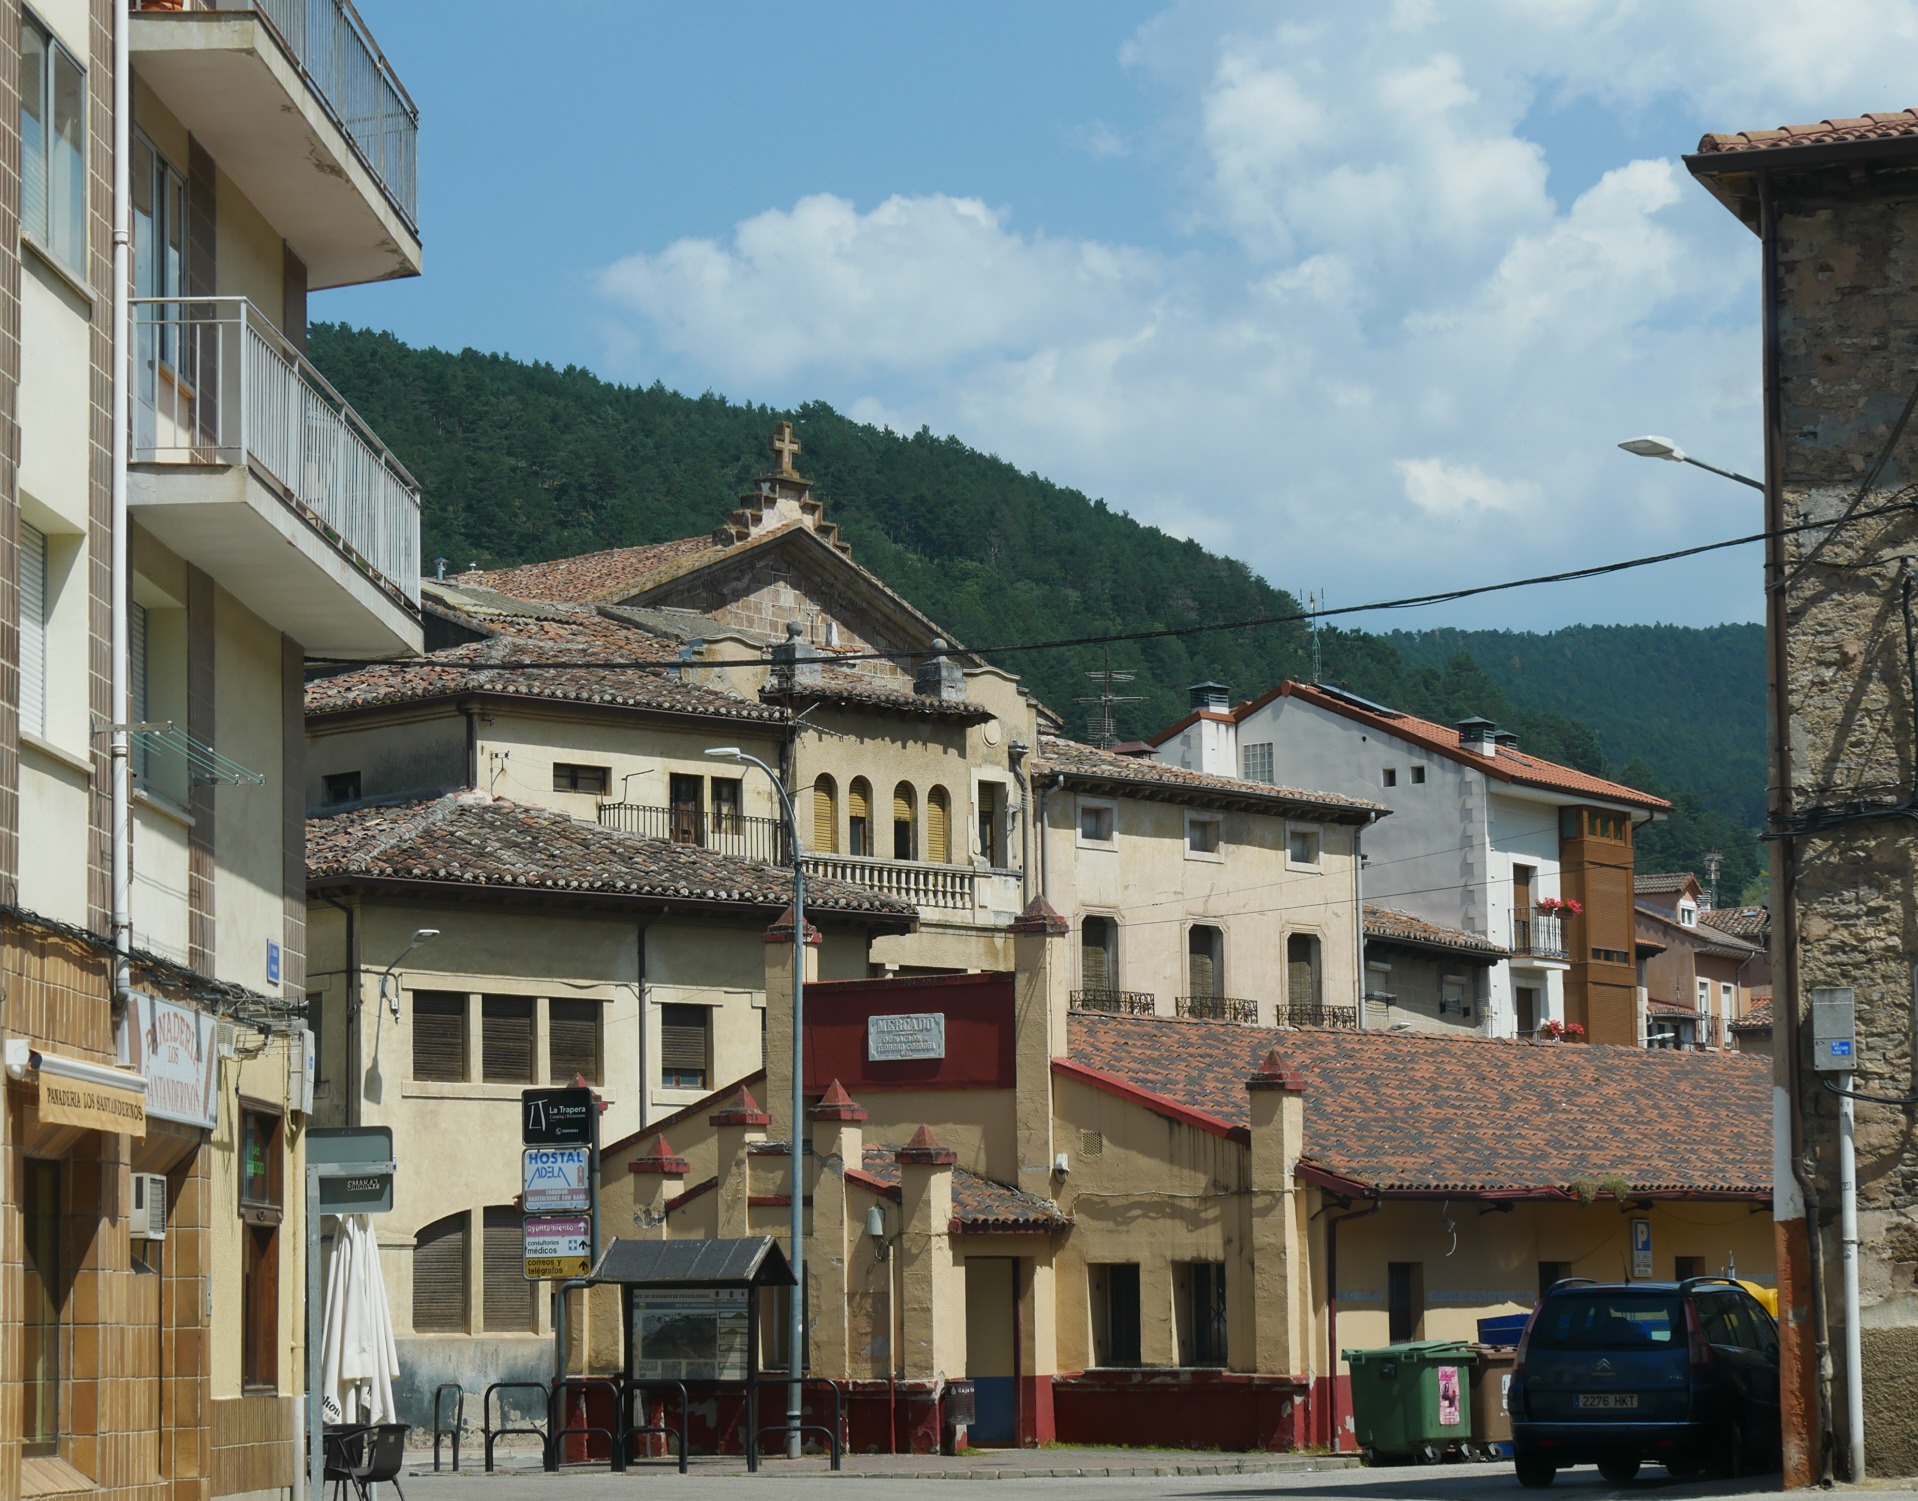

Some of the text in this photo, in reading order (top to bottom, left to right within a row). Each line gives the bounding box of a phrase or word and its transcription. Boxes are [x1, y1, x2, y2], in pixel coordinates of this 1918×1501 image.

[876, 1017, 934, 1032] MERCADO
[145, 1010, 200, 1075] PANADERIA
[167, 1044, 179, 1064] LOS
[47, 1087, 81, 1108] PANADERIA
[83, 1092, 96, 1110] LOS
[549, 1105, 586, 1115] La Trapera
[528, 1152, 584, 1165] HOSTAL
[527, 1166, 571, 1189] ADELA
[527, 1224, 574, 1233] ayuntamiento
[527, 1239, 560, 1247] consultorios
[527, 1246, 558, 1255] médicos
[527, 1266, 563, 1275] telégrafos
[1582, 1395, 1636, 1407] 2276 HKT
